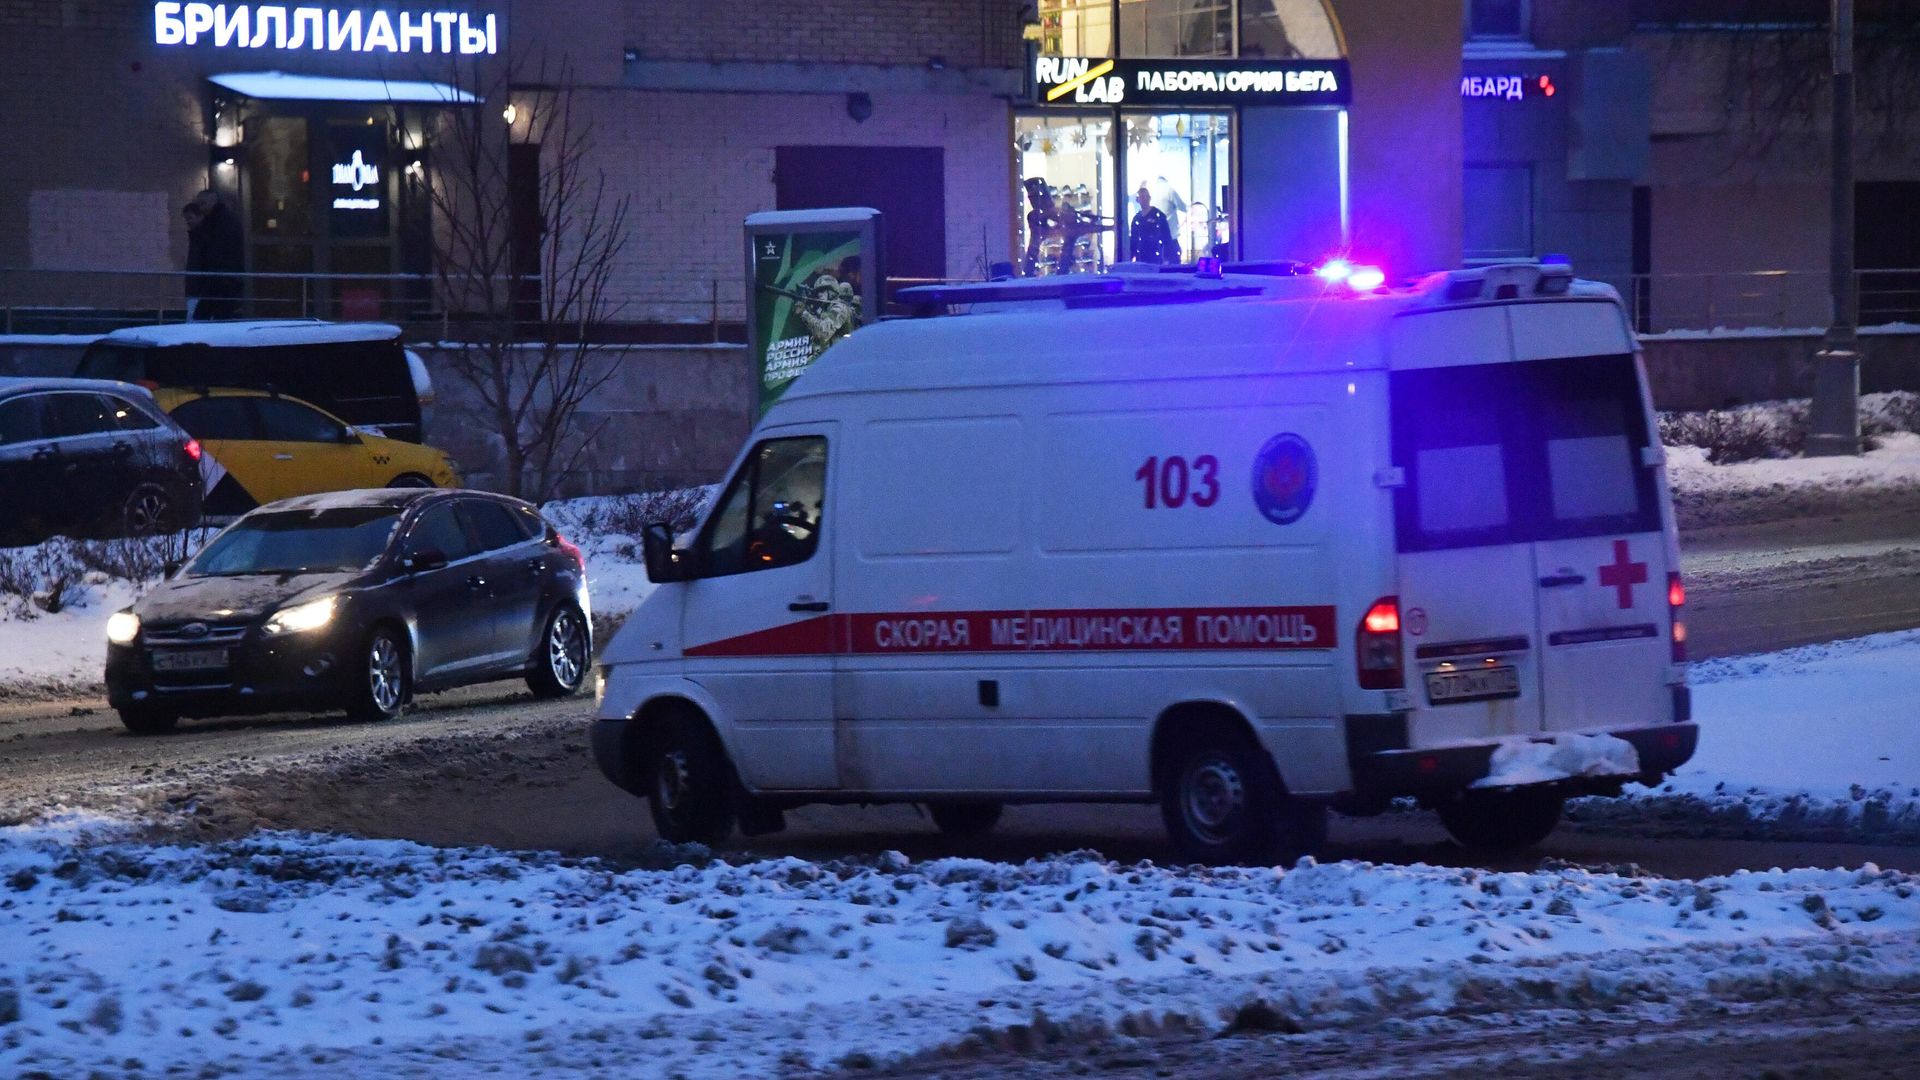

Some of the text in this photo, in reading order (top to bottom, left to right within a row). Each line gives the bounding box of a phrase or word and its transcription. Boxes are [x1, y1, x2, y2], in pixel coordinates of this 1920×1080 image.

[154, 1, 496, 55] БРИЛЛИАНТЫ
[1036, 57, 1088, 86] RUN
[1285, 71, 1338, 92] БЕГА
[1075, 76, 1124, 103] LAB
[766, 345, 813, 361] РОССИИ
[767, 335, 810, 352] АРМИЯ
[765, 355, 808, 372] АРМИЯ
[1135, 455, 1220, 509] 103
[875, 614, 1317, 647] СКОРАЯ МЕДИЦИНСКАЯ ПОМОЩЬ
